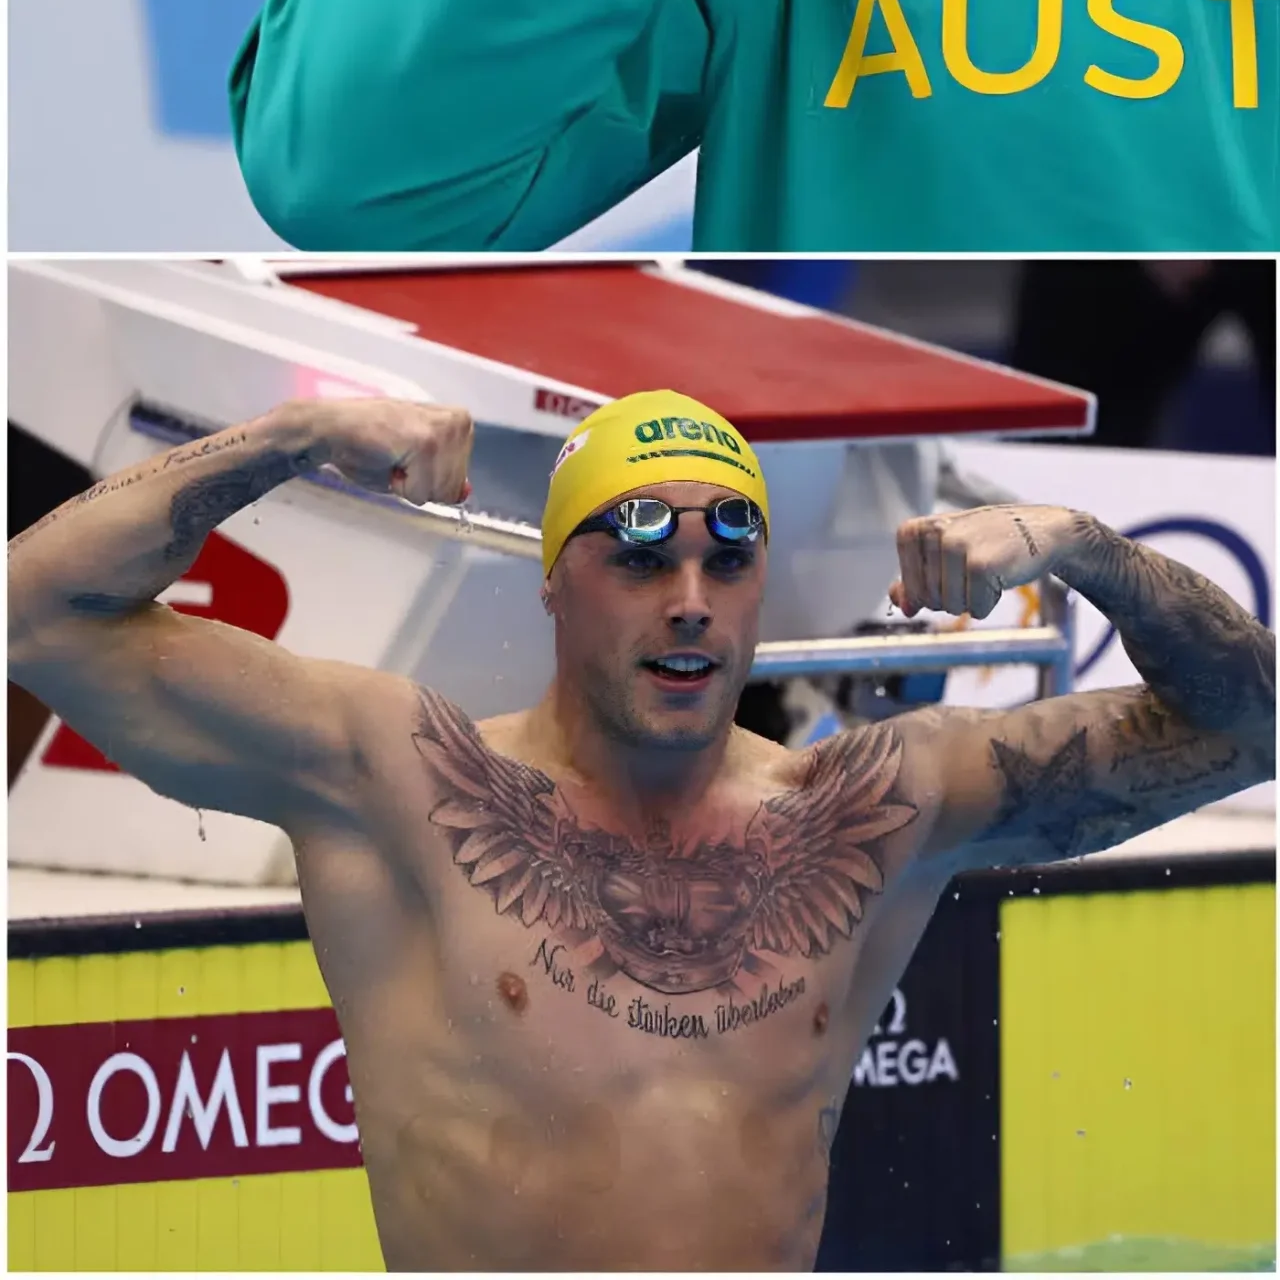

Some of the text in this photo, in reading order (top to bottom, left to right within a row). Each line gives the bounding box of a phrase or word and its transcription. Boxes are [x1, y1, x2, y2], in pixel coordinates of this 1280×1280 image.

[634, 416, 742, 455] arena
[528, 938, 576, 993] Nur
[587, 978, 620, 1018] die
[853, 1037, 961, 1087] MEGA
[87, 1038, 359, 1158] OMEG
